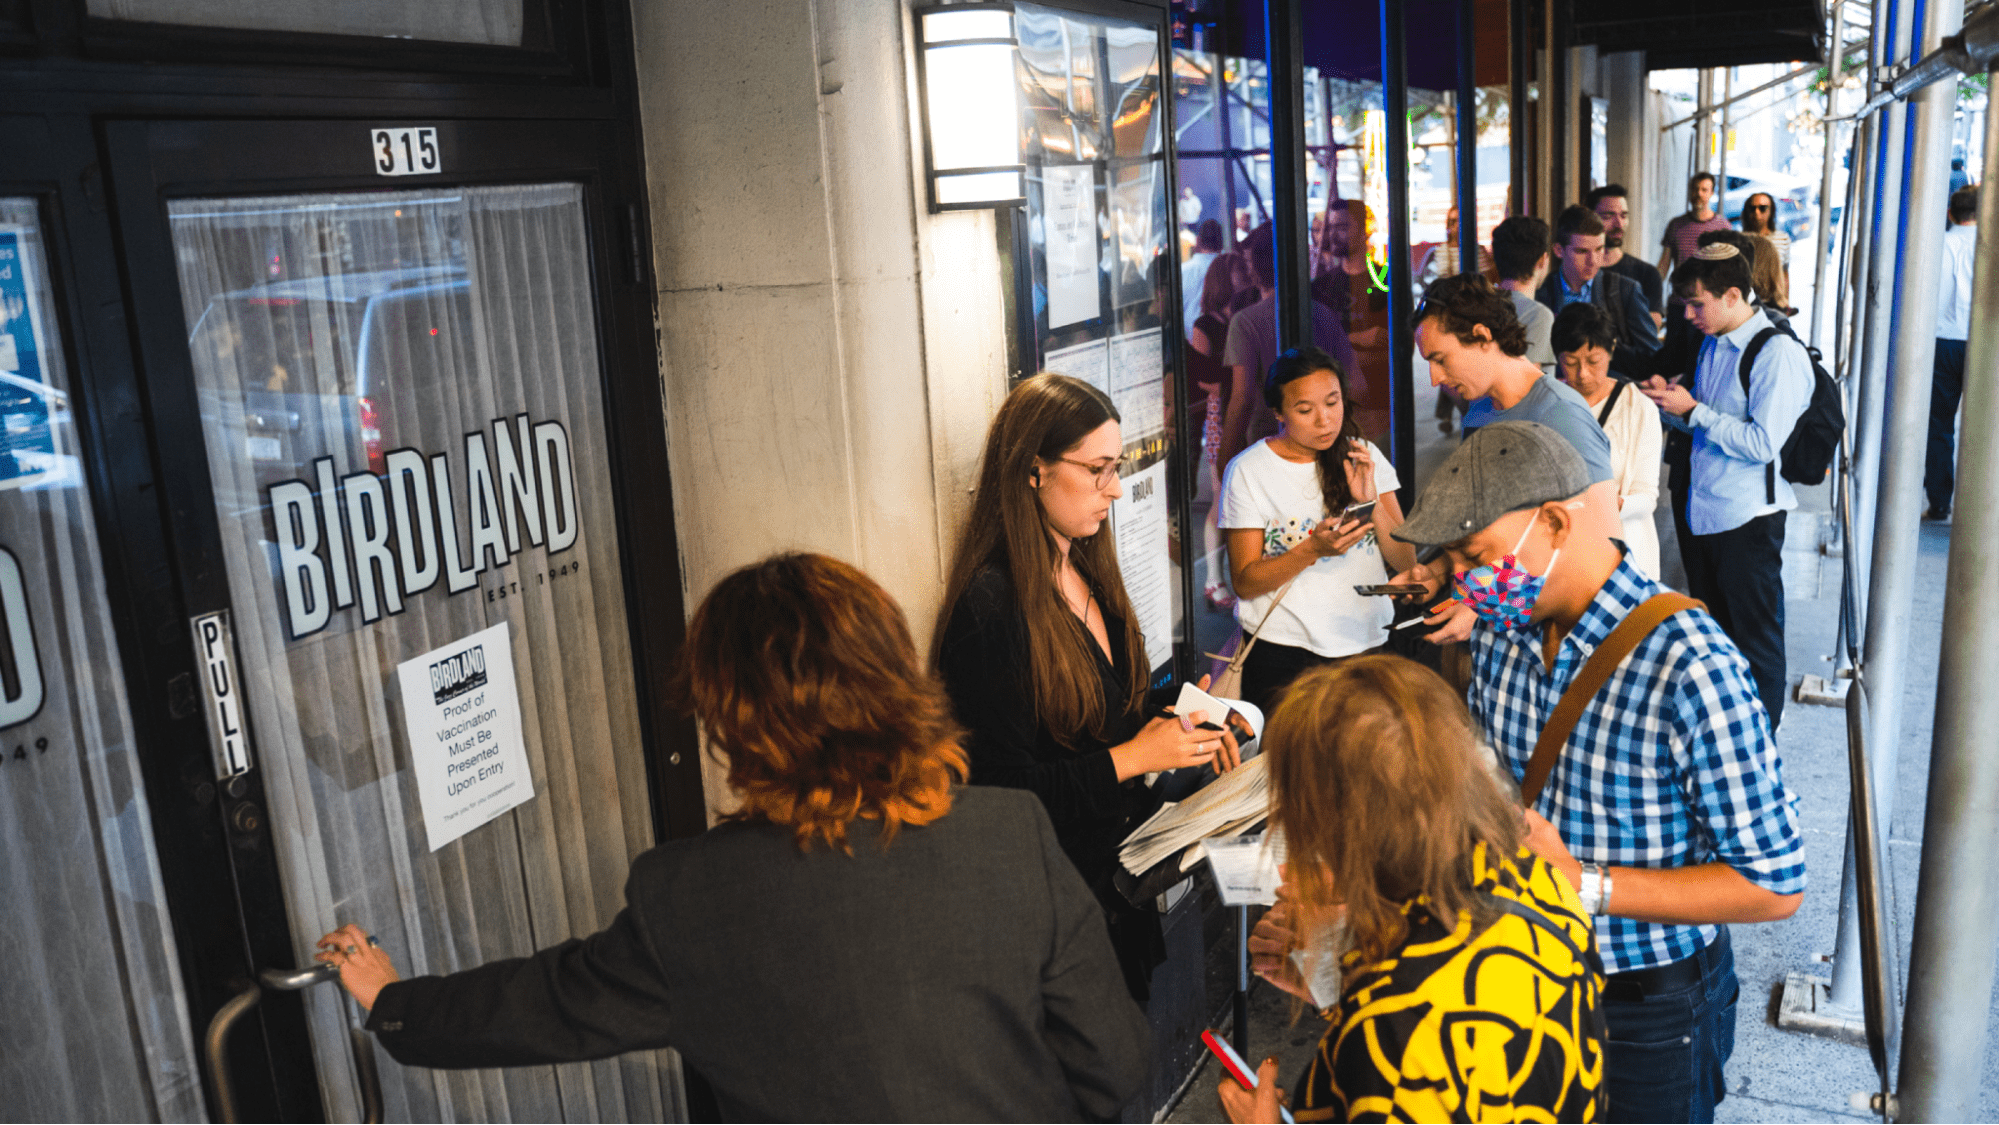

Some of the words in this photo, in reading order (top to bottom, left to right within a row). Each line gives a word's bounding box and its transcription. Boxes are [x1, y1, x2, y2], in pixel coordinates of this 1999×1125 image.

[376, 131, 437, 173] 315
[267, 412, 578, 641] BIRDLAND
[487, 582, 525, 603] EST.
[537, 560, 579, 585] 1949
[430, 648, 485, 692] BIRDLAND
[203, 622, 246, 775] PULL
[443, 698, 472, 720] Proof
[474, 692, 486, 707] of
[436, 708, 497, 743] Vaccination
[448, 736, 475, 758] Must
[477, 729, 492, 744] Be
[447, 743, 499, 777] Presented
[447, 775, 477, 797] Upon
[478, 761, 504, 782] Entry
